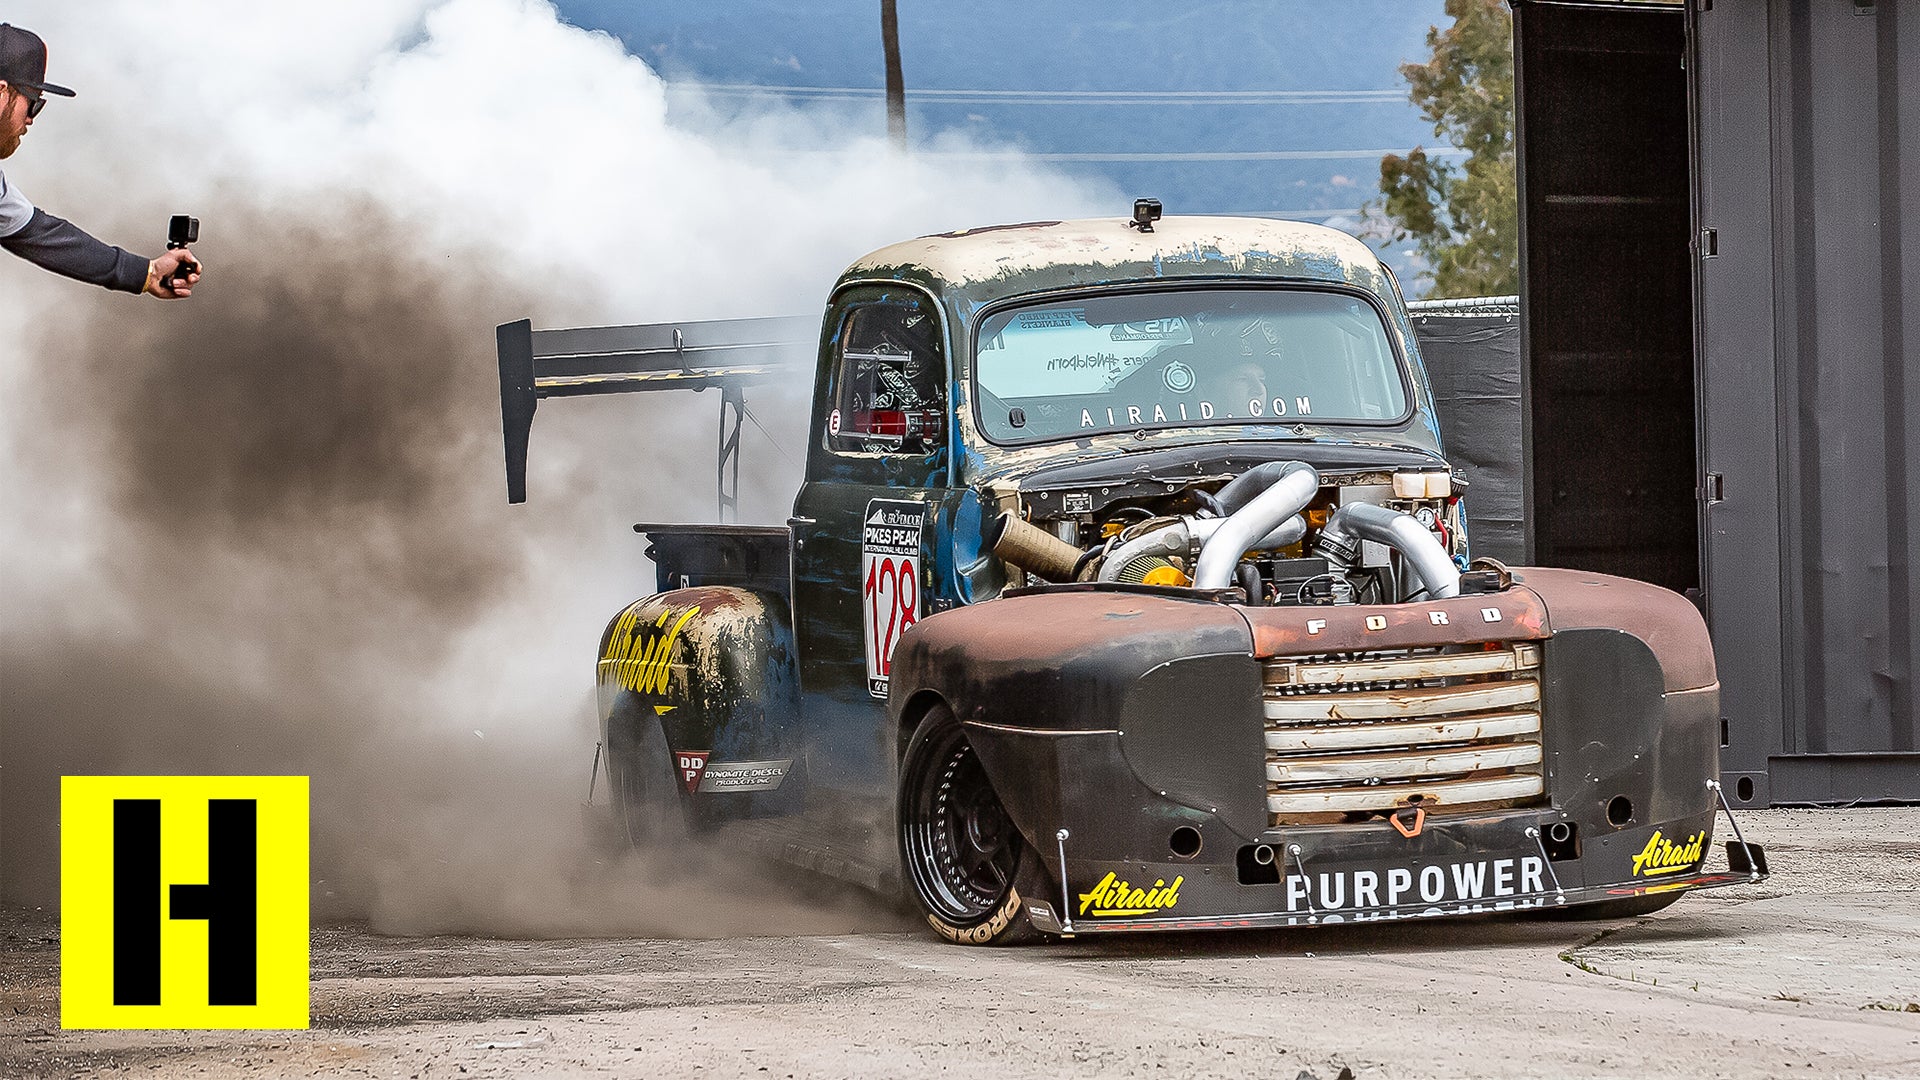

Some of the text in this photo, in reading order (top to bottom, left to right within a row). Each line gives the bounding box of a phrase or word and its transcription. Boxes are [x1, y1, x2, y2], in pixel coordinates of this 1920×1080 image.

[831, 416, 839, 431] E
[1080, 396, 1312, 428] AIRAID.COM
[865, 527, 919, 546] PIKES PEAK
[866, 556, 917, 676] 128
[1306, 606, 1504, 635] FORD
[680, 757, 704, 769] DD
[686, 770, 697, 782] P
[704, 768, 783, 779] DYNOMITE DIESEL
[1632, 830, 1706, 877] Airaid
[1079, 871, 1184, 917] Airaid
[1286, 856, 1545, 912] PURPOWER
